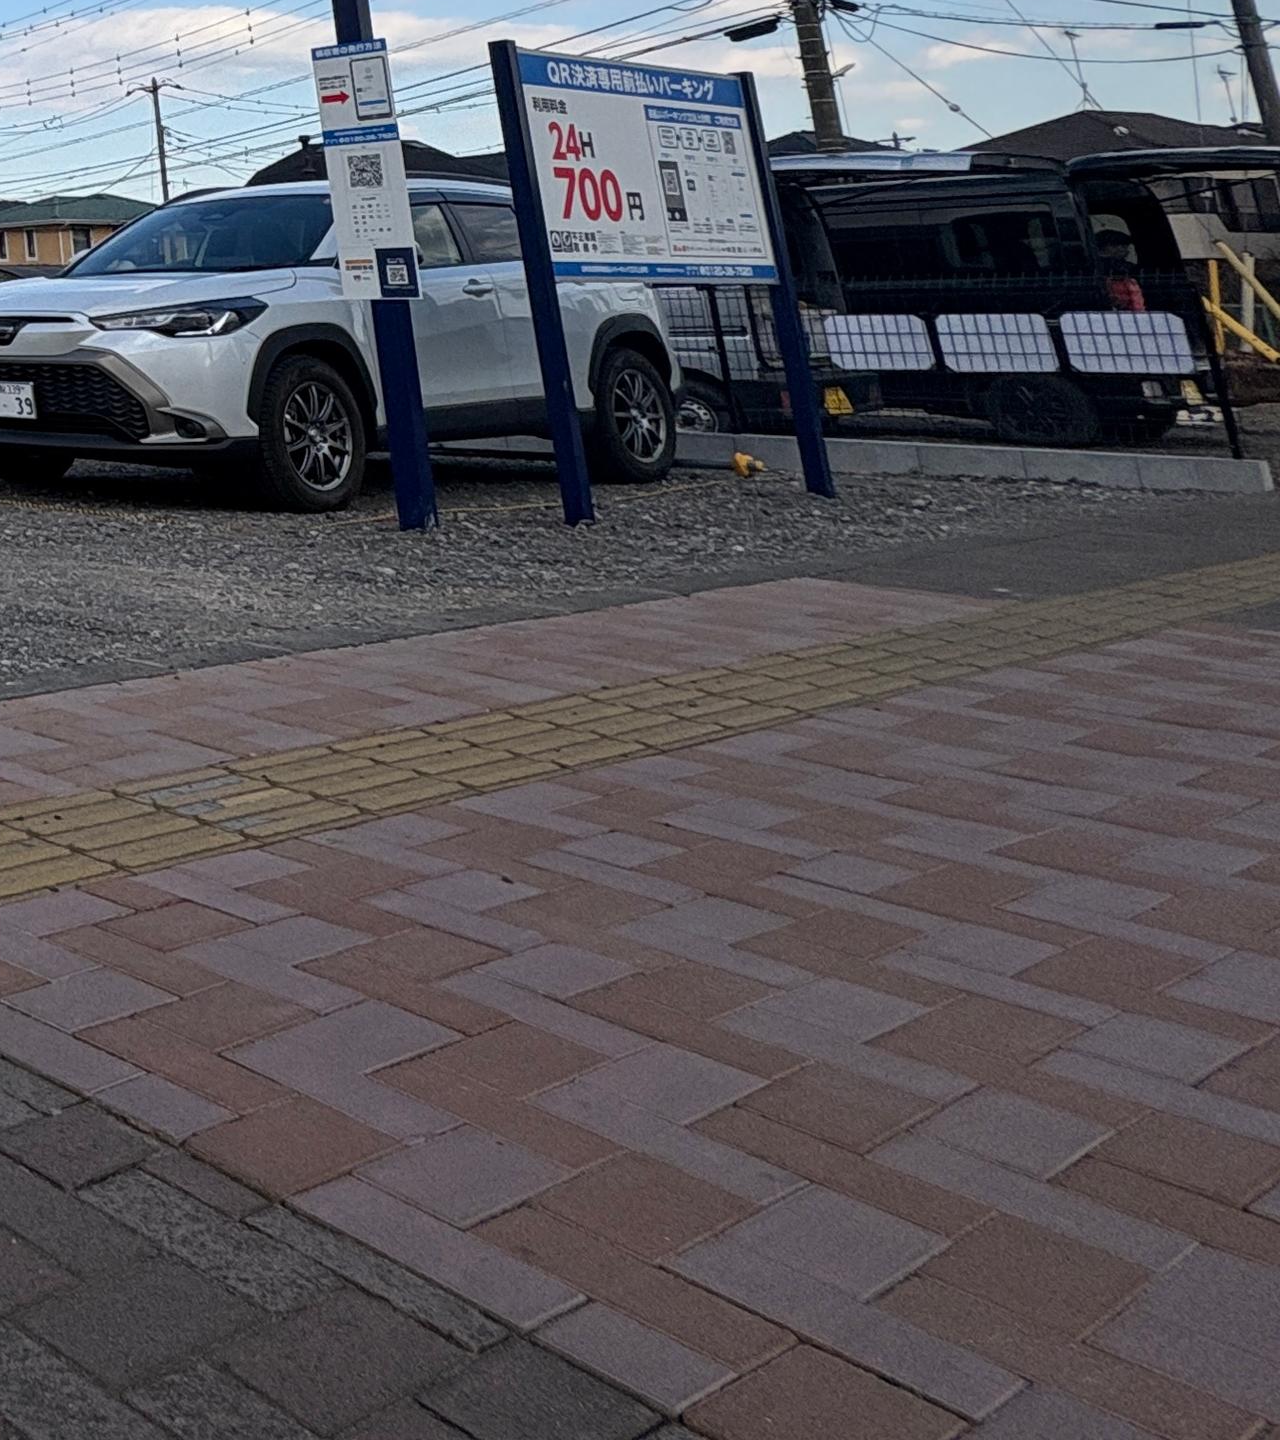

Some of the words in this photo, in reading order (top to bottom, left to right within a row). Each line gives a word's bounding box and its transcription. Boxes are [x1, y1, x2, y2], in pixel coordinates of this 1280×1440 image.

[547, 61, 715, 101] QR決済専用前払いパーキング
